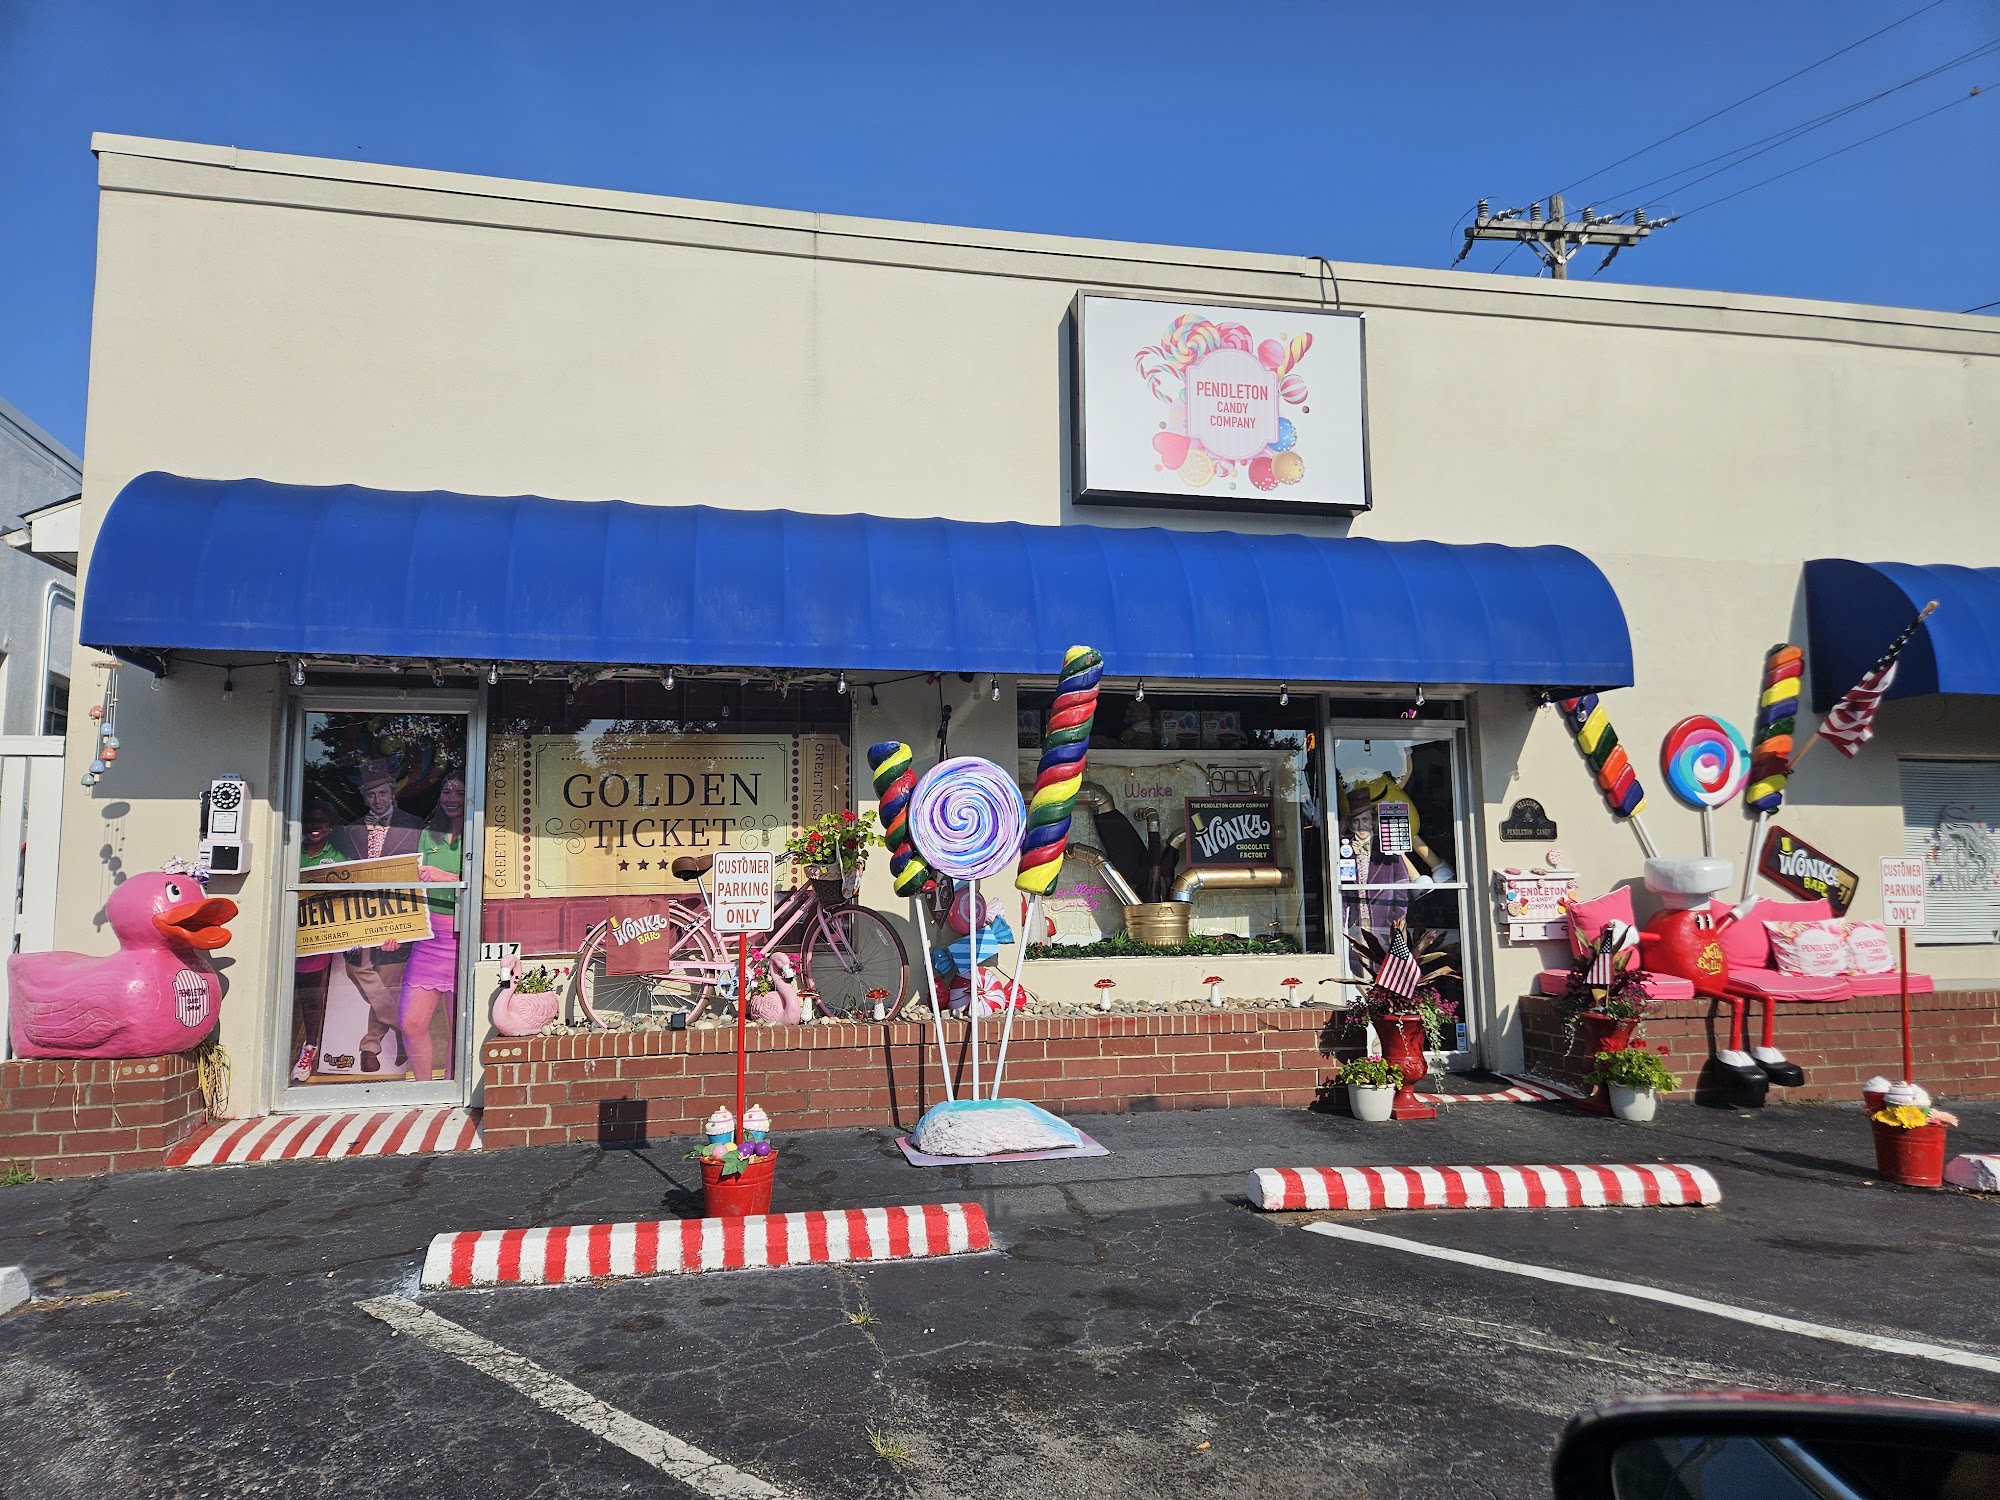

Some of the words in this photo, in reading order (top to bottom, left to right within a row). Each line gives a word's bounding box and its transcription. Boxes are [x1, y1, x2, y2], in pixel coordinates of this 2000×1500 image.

[1196, 381, 1268, 400] PENDLETON
[1217, 401, 1248, 414] CANDY
[1210, 415, 1256, 429] COMPANY
[494, 779, 506, 797] TO
[812, 743, 825, 821] GREETINGS
[1211, 769, 1266, 793] OPEN
[563, 773, 762, 809] GOLDEN
[1516, 800, 1541, 811] WELCOME
[589, 818, 736, 849] TICKET
[1195, 814, 1271, 858] WONKA
[494, 805, 507, 888] GREETINGS
[718, 859, 769, 874] CUSTOMER
[1883, 864, 1921, 877] CUSTOMER
[717, 882, 769, 897] PARKING
[1056, 882, 1110, 895] endleton
[1514, 887, 1567, 896] PENDLETON
[1884, 884, 1922, 896] PARKING
[342, 888, 419, 921] TICKET
[726, 909, 760, 923] ONLY
[1892, 907, 1917, 920] ONLY
[364, 925, 389, 935] FRONT
[389, 922, 412, 931] GATES
[612, 914, 668, 946] WONKA
[637, 932, 660, 945] BAR
[485, 944, 519, 959] 117
